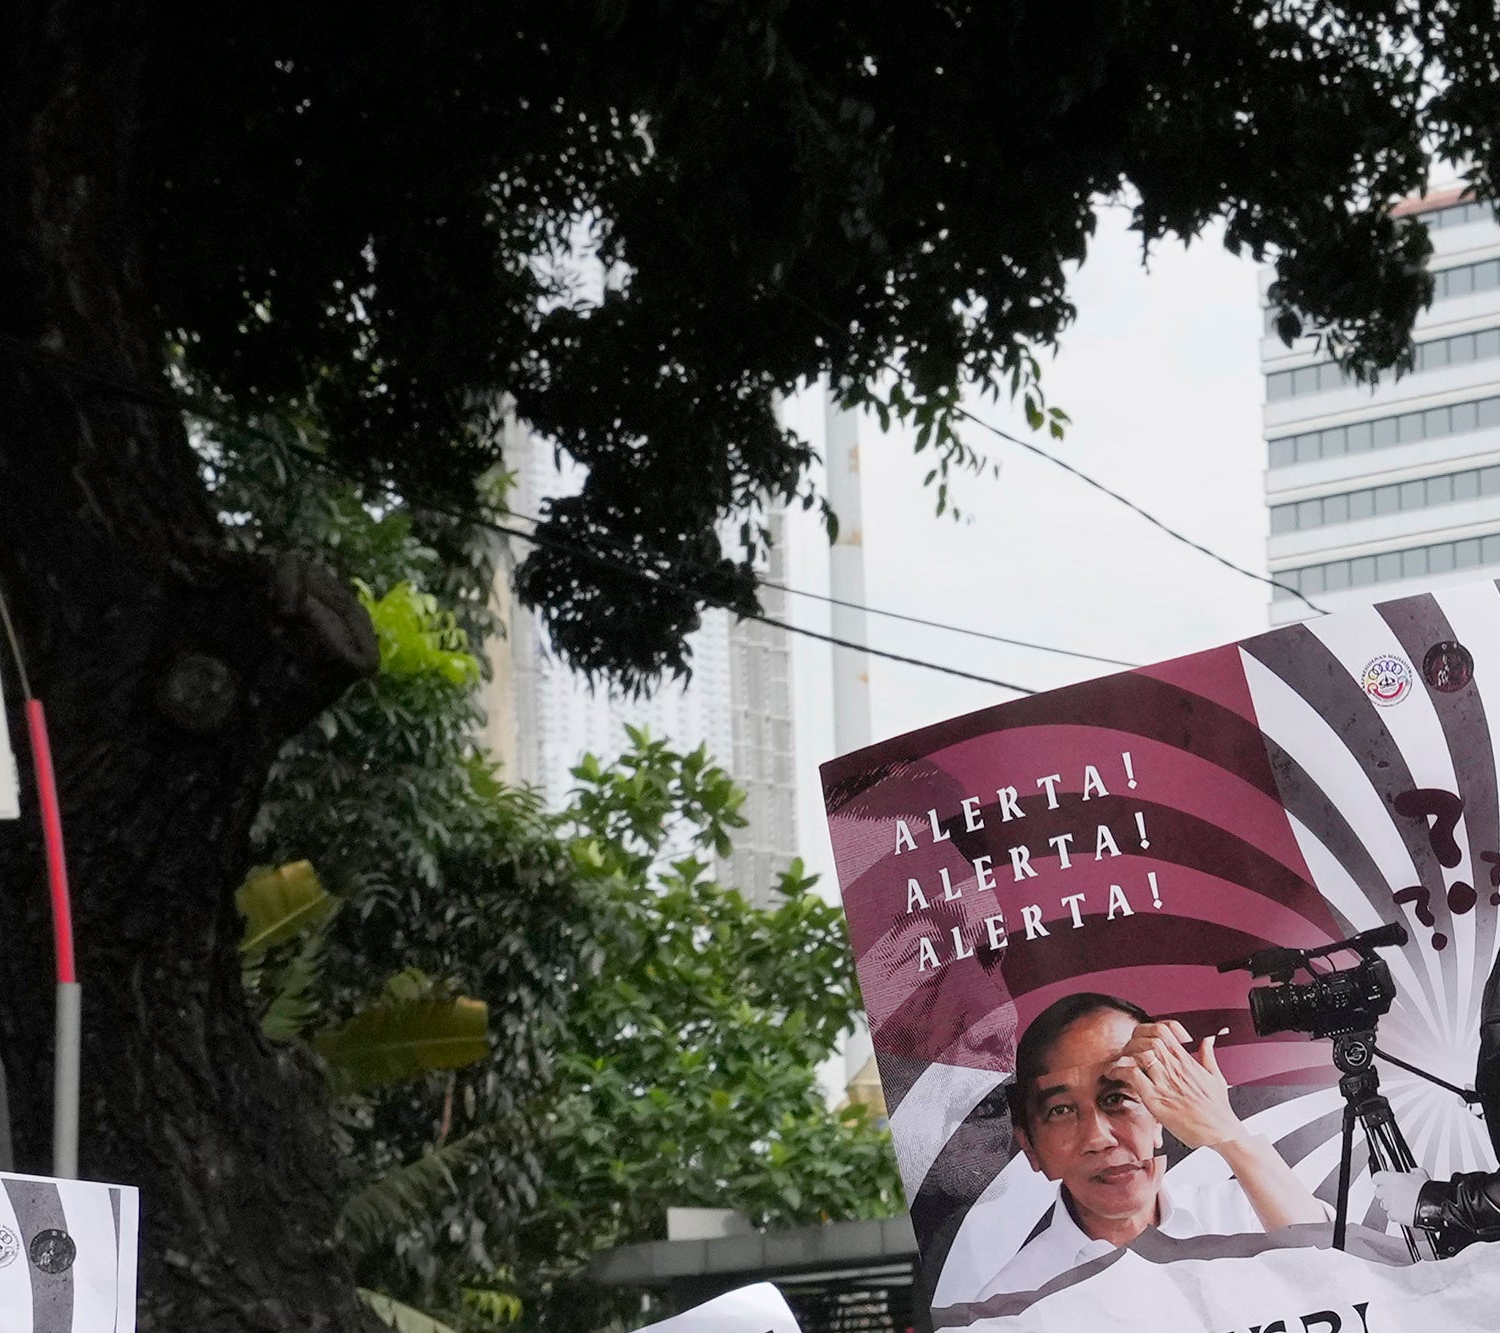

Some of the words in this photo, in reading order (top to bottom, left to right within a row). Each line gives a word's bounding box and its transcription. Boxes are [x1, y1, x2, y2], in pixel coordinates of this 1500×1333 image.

[893, 751, 1141, 856] ALERTA!
[905, 811, 1152, 915] ALERTA!
[916, 870, 1164, 974] ALERTA!
